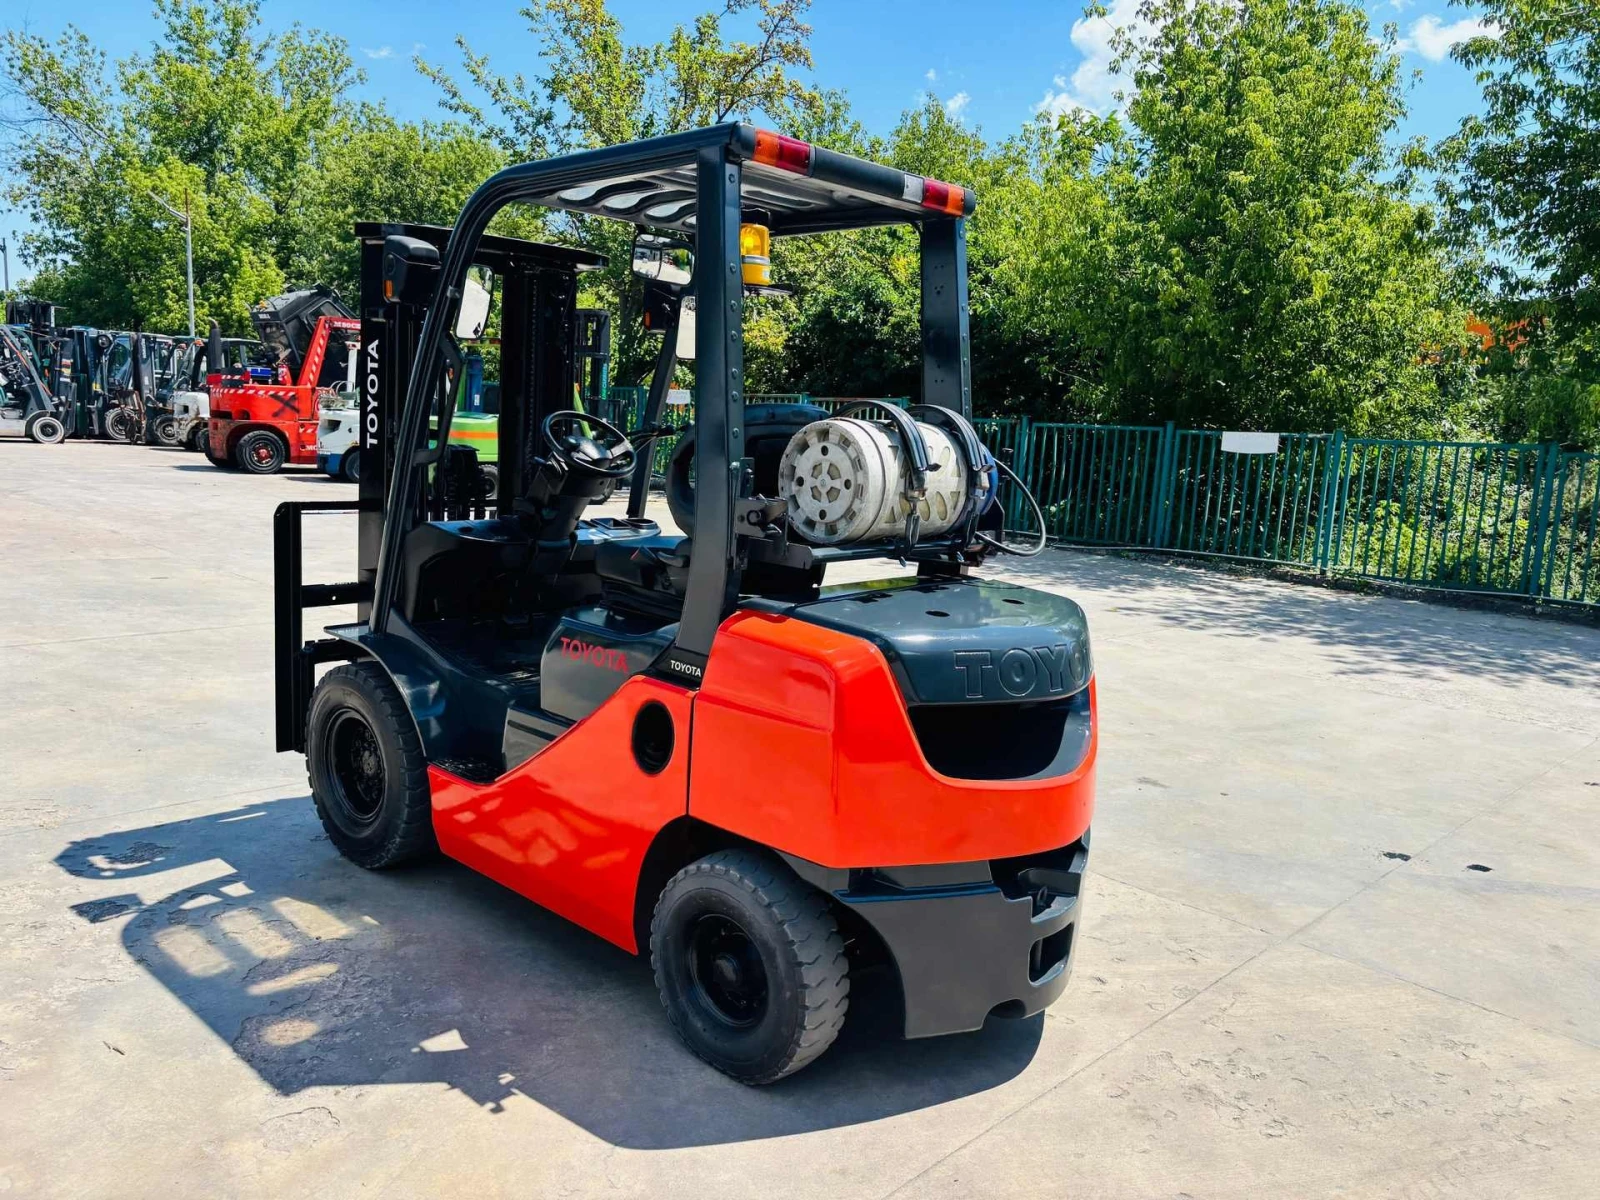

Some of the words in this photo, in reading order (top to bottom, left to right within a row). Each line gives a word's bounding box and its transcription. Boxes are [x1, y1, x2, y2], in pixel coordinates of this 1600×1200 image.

[367, 339, 379, 449] TOYOTA
[561, 637, 629, 673] TOYOTA
[670, 660, 701, 677] TOYOTA
[953, 640, 1088, 698] TOYO
